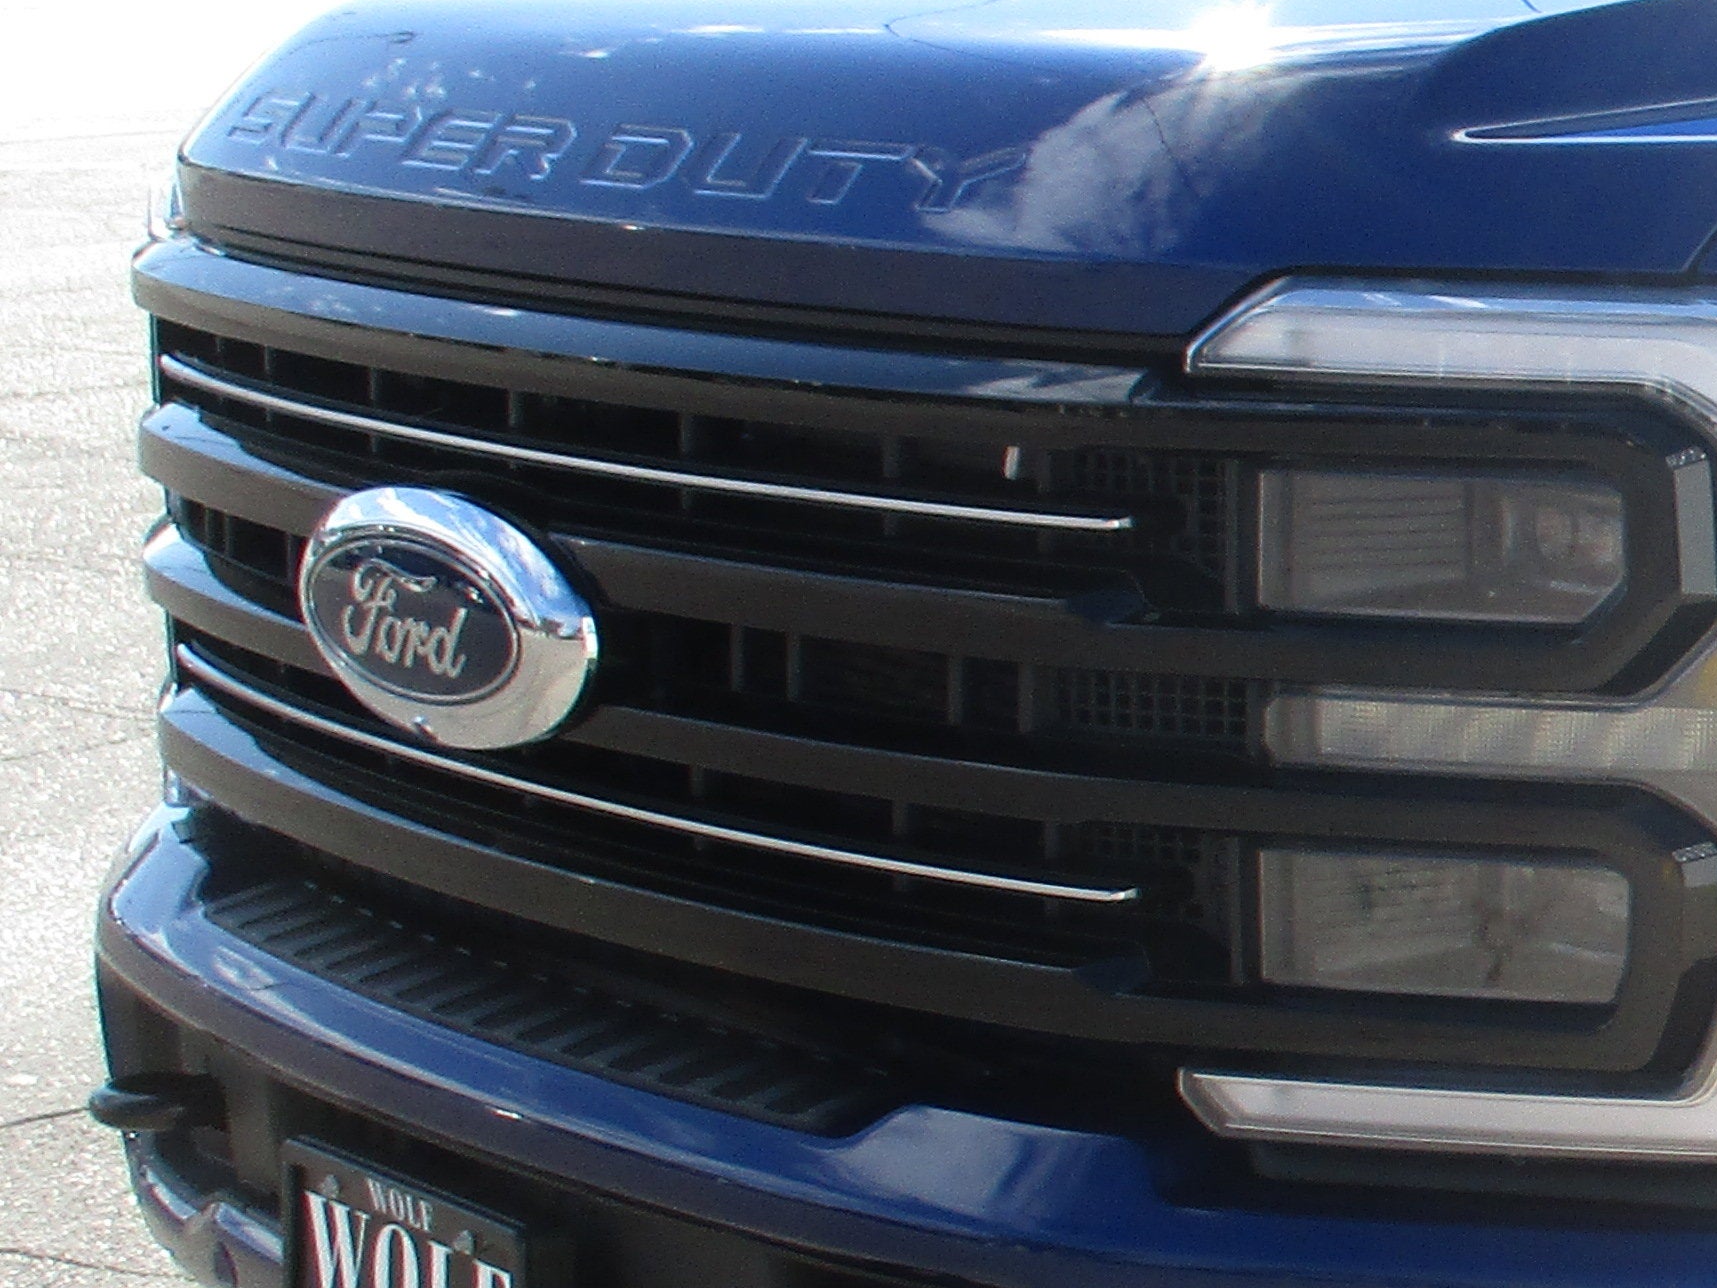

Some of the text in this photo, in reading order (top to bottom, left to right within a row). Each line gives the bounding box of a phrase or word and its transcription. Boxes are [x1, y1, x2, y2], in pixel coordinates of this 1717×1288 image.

[226, 91, 1028, 213] SUPER DUTY
[341, 558, 466, 679] Ford
[366, 1177, 432, 1232] WOLF
